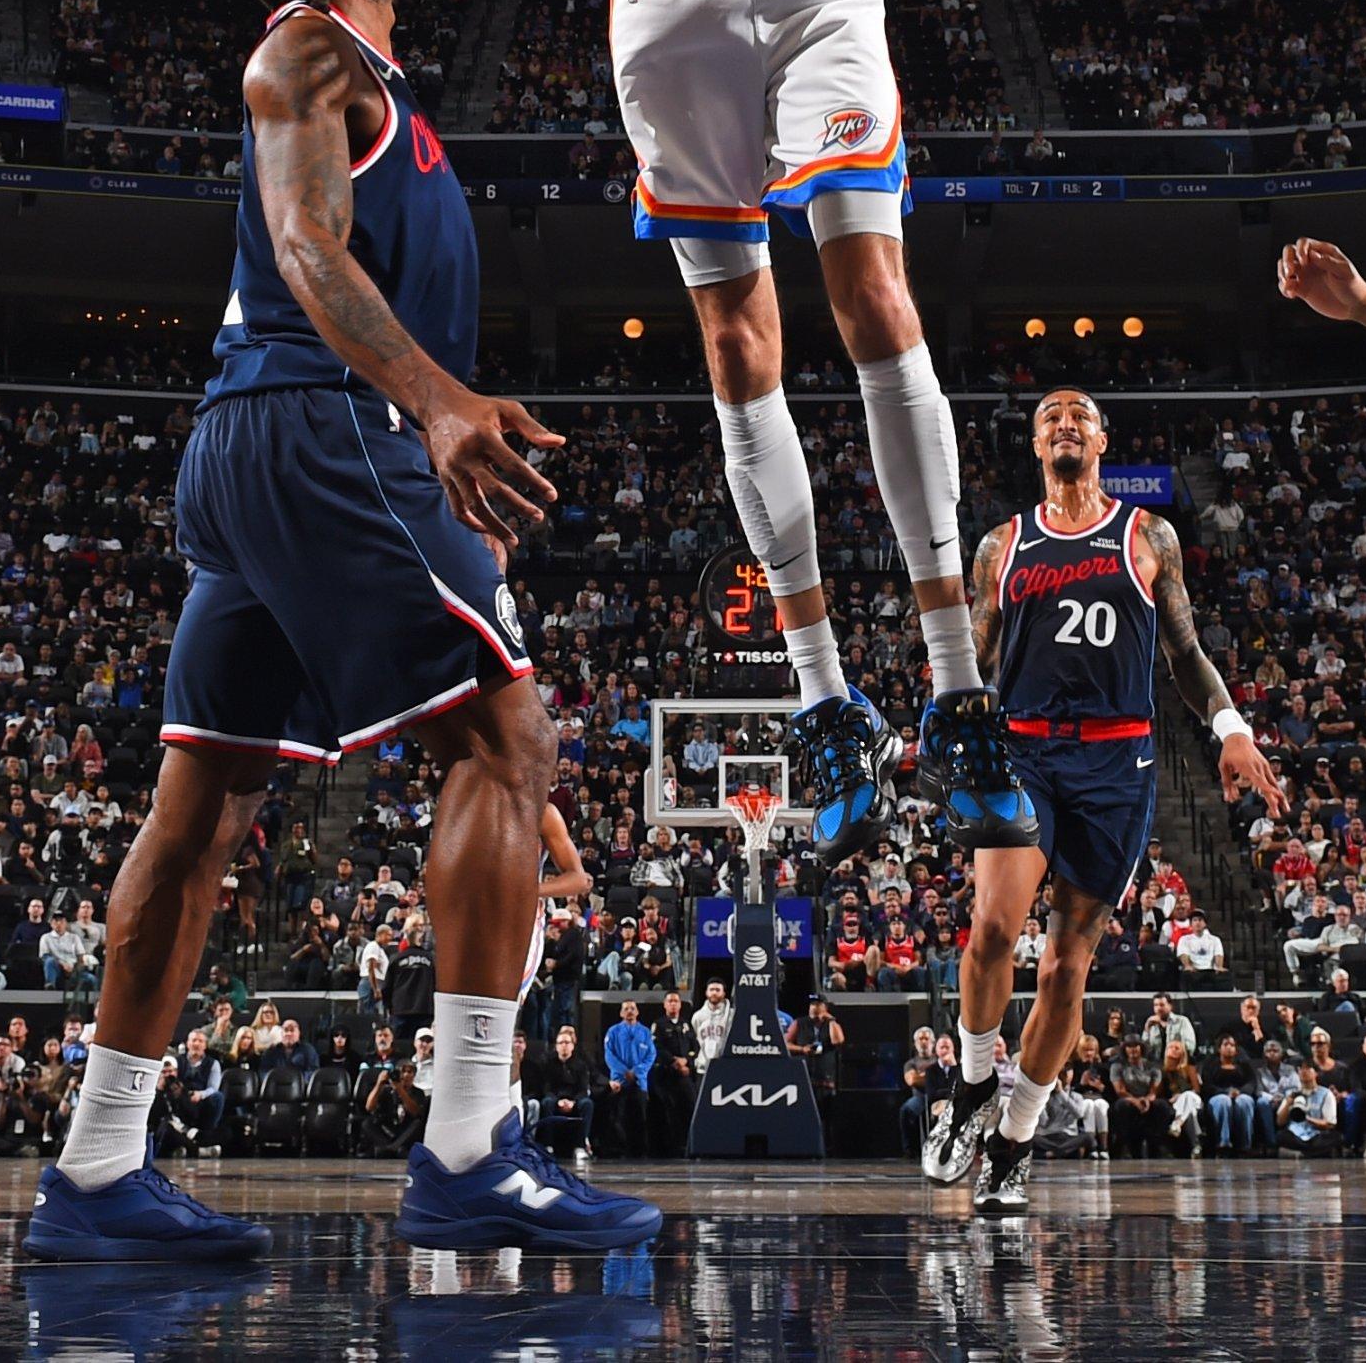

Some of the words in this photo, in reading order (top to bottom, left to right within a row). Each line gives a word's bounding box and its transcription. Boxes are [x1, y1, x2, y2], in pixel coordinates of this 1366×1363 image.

[0, 173, 32, 182] CLEAR
[486, 184, 496, 199] 6
[541, 184, 560, 199] 12
[945, 182, 966, 197] 25
[1030, 182, 1039, 196] 7
[1092, 181, 1102, 196] 2
[1008, 554, 1120, 604] Clippers
[1054, 598, 1117, 648] 20
[739, 974, 771, 987] AT&T
